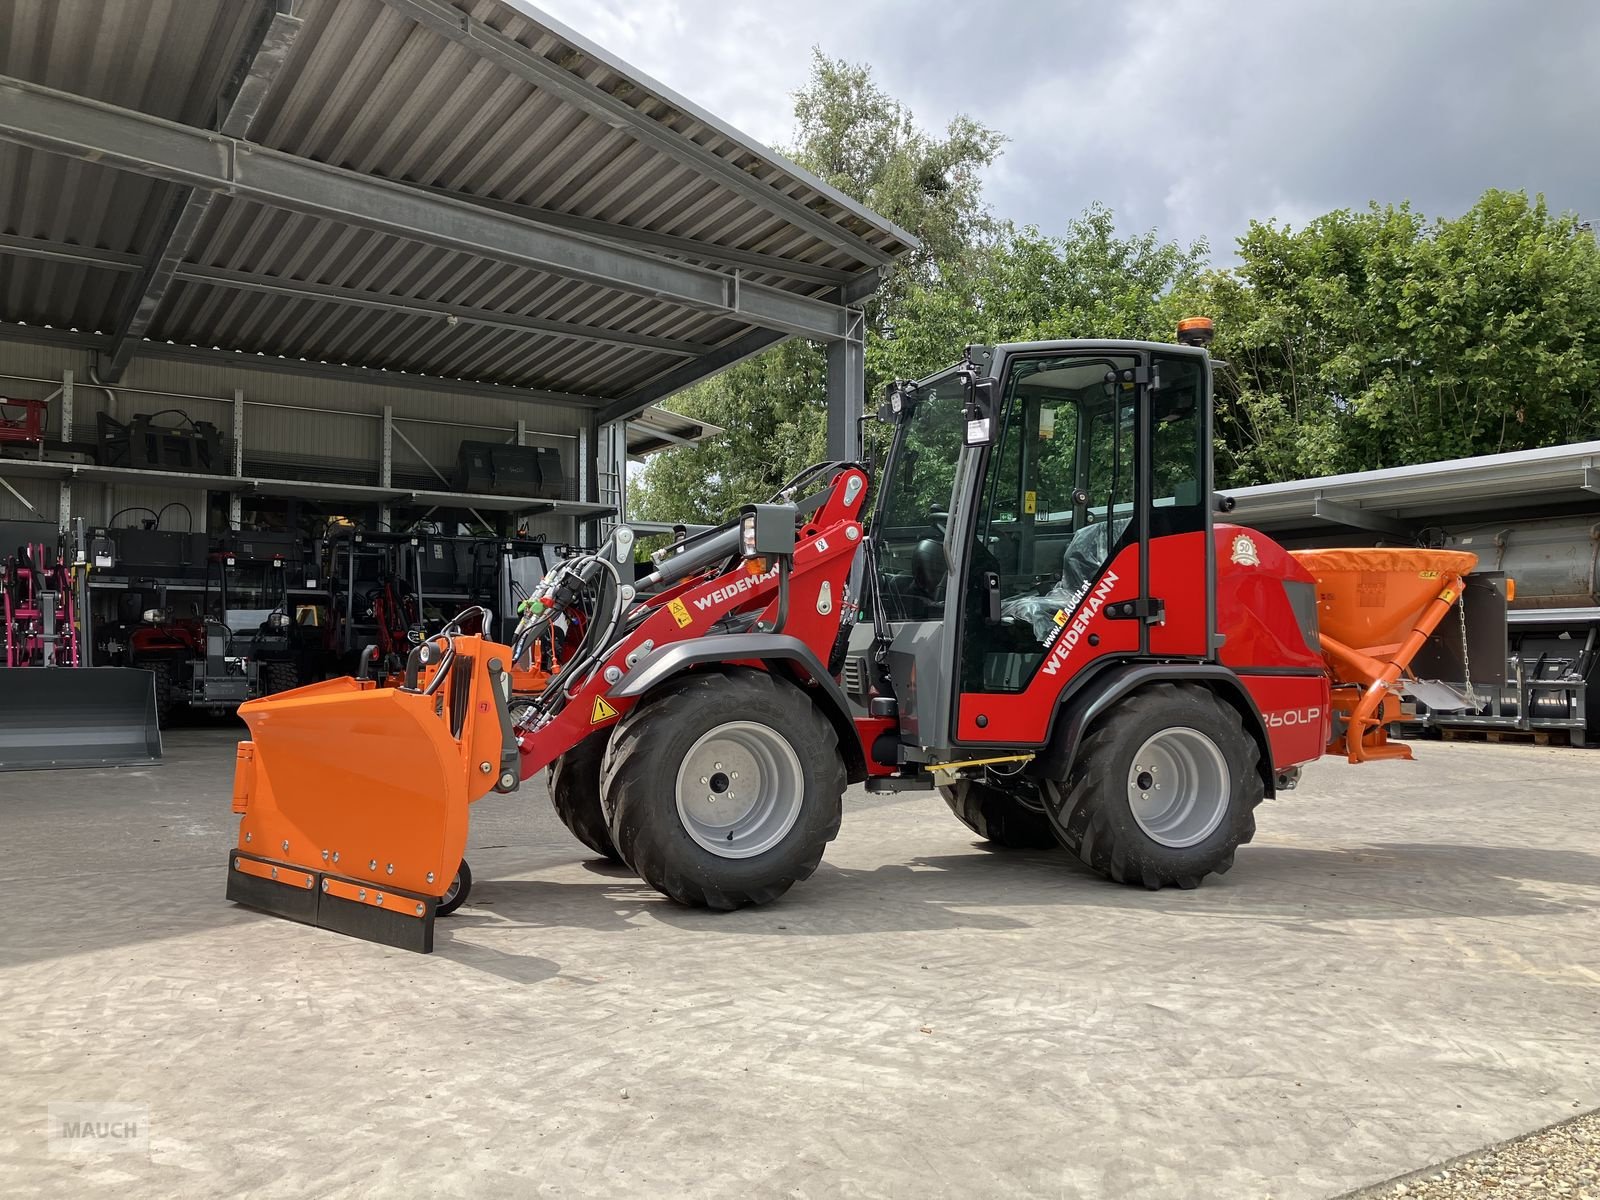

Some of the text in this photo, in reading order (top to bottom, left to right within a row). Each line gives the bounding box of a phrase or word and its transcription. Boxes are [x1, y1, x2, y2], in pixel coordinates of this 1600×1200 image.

[693, 562, 793, 611] WEIDEMAN
[1042, 579, 1092, 649] www.MAUCH.at
[1042, 570, 1120, 676] WEIDEMANN
